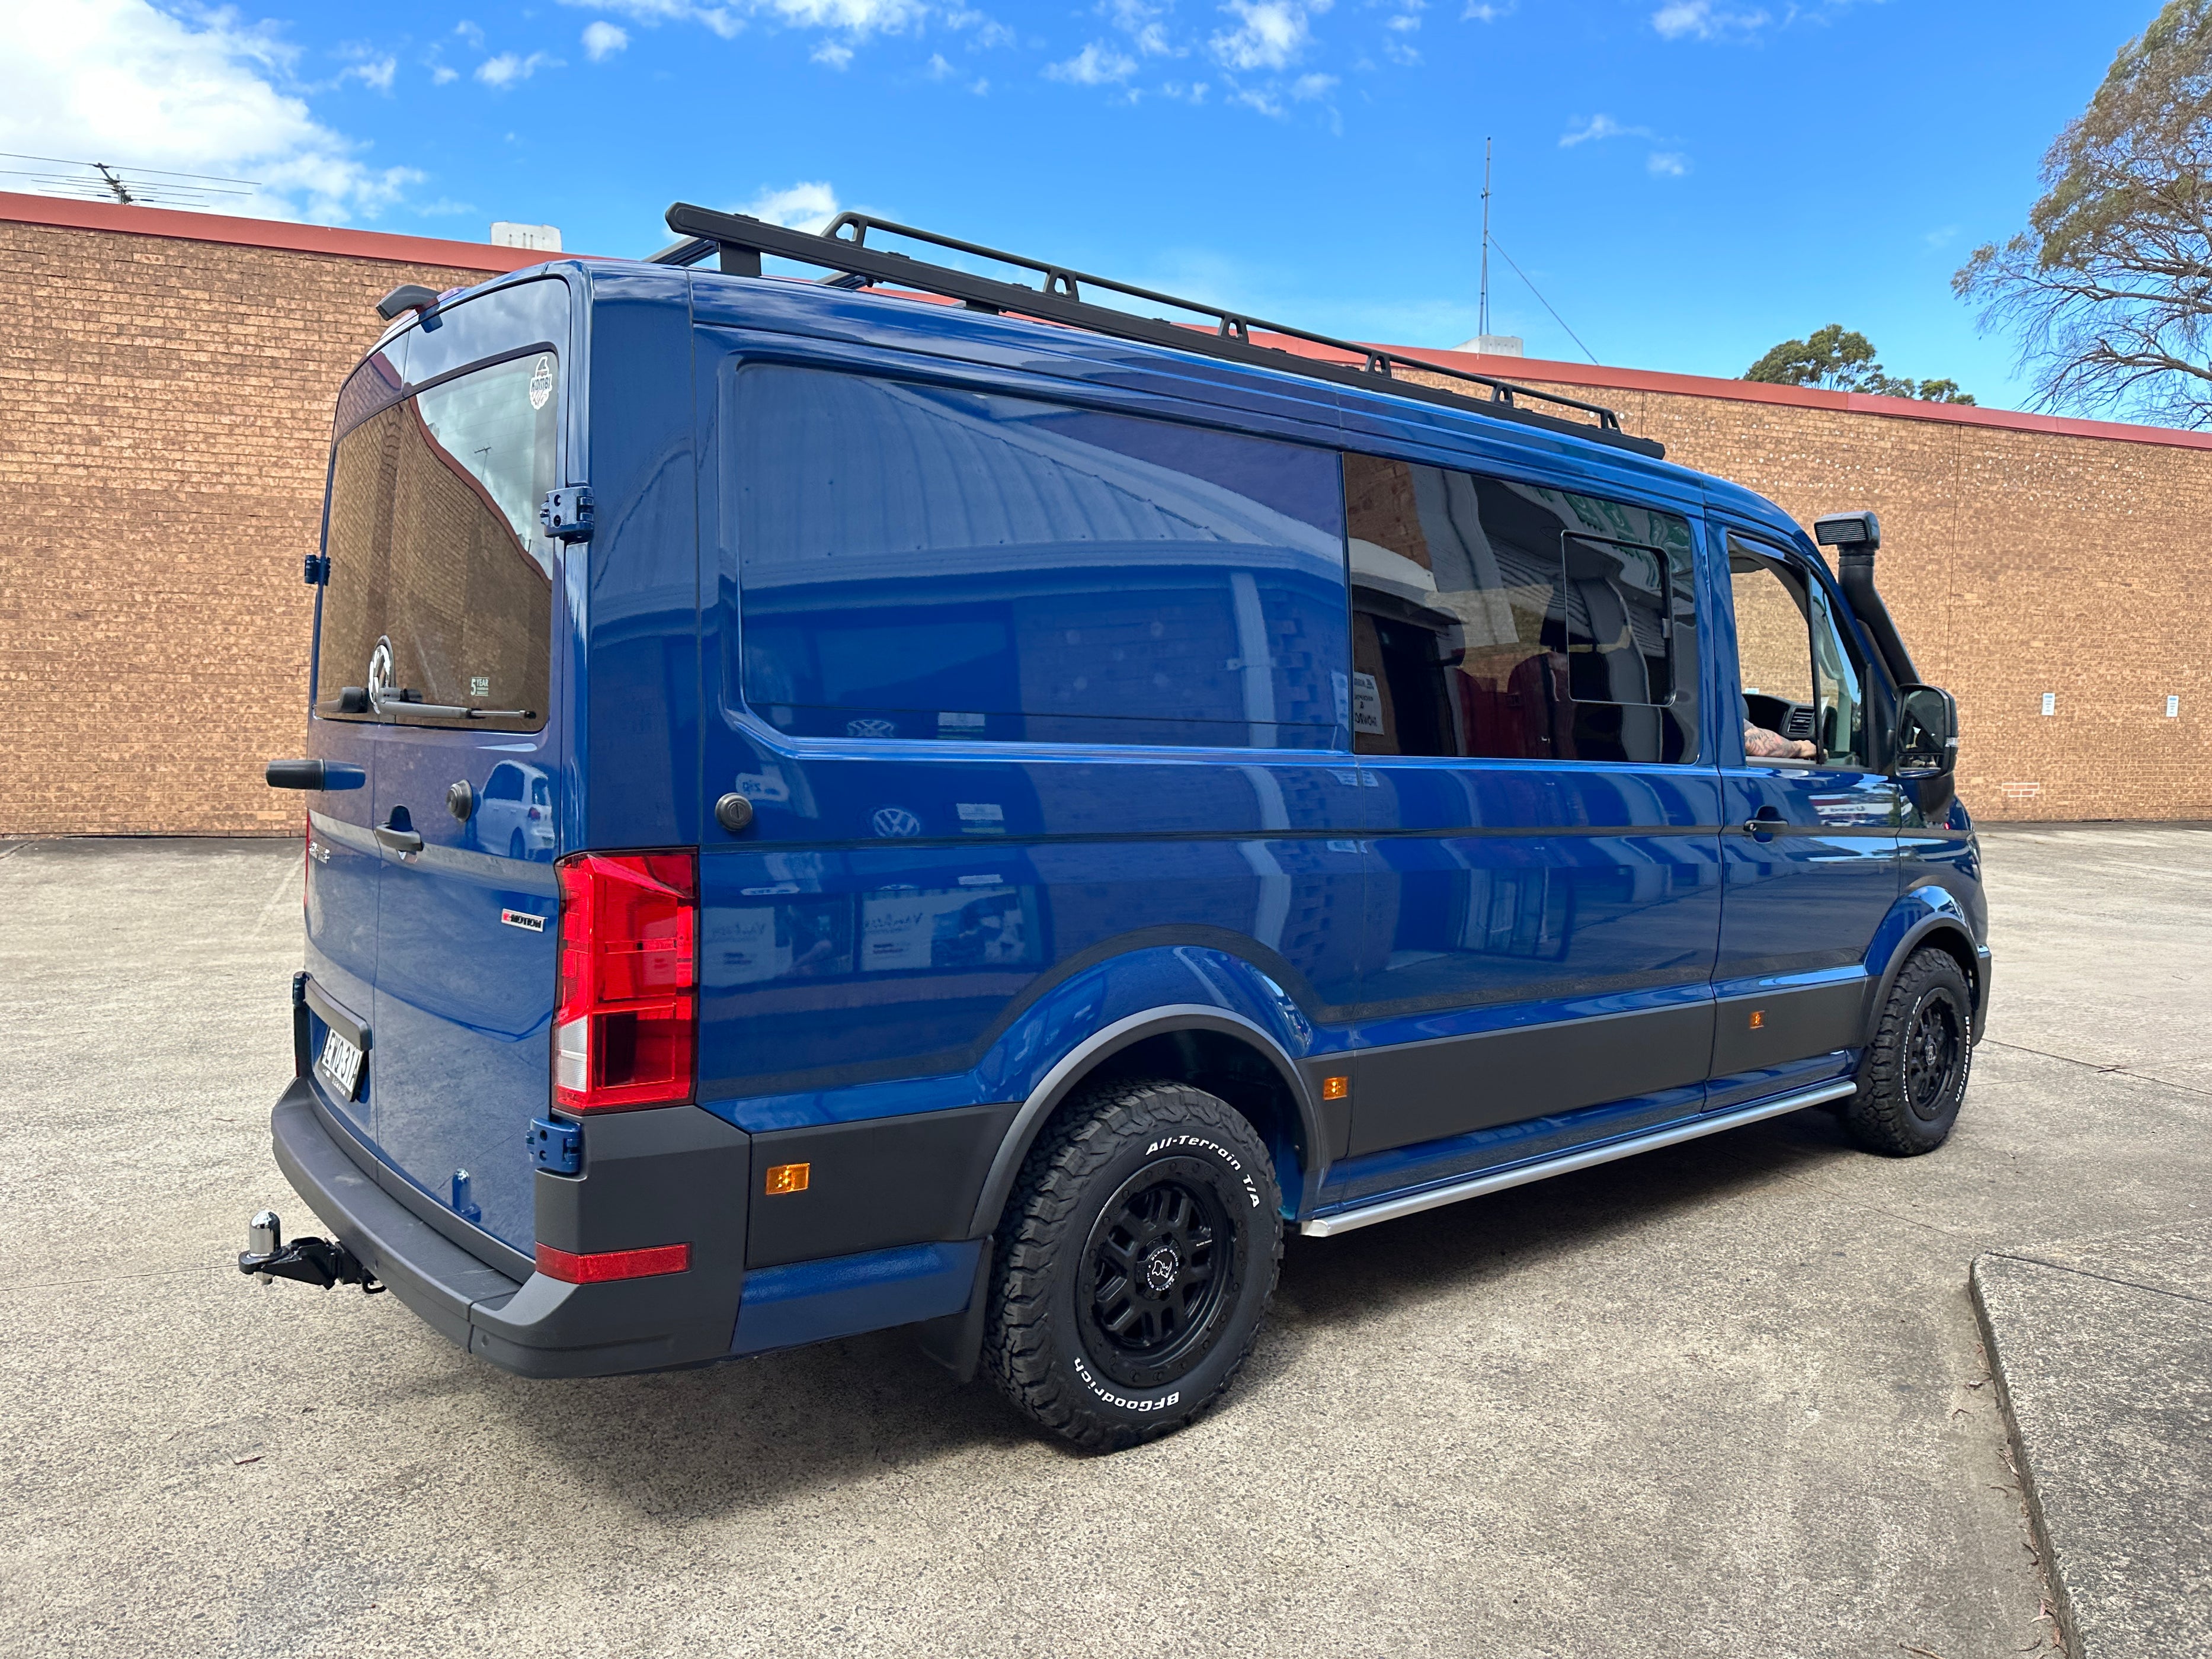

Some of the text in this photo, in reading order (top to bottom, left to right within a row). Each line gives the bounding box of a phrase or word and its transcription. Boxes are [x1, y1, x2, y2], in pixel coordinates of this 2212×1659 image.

[531, 376, 551, 392] KOMBI
[470, 678, 489, 696] 5 YEAR
[1145, 1135, 1260, 1208] All-Terrain T/A
[1151, 1248, 1168, 1261] BLACK
[1074, 1356, 1180, 1412] BFGoodrich
